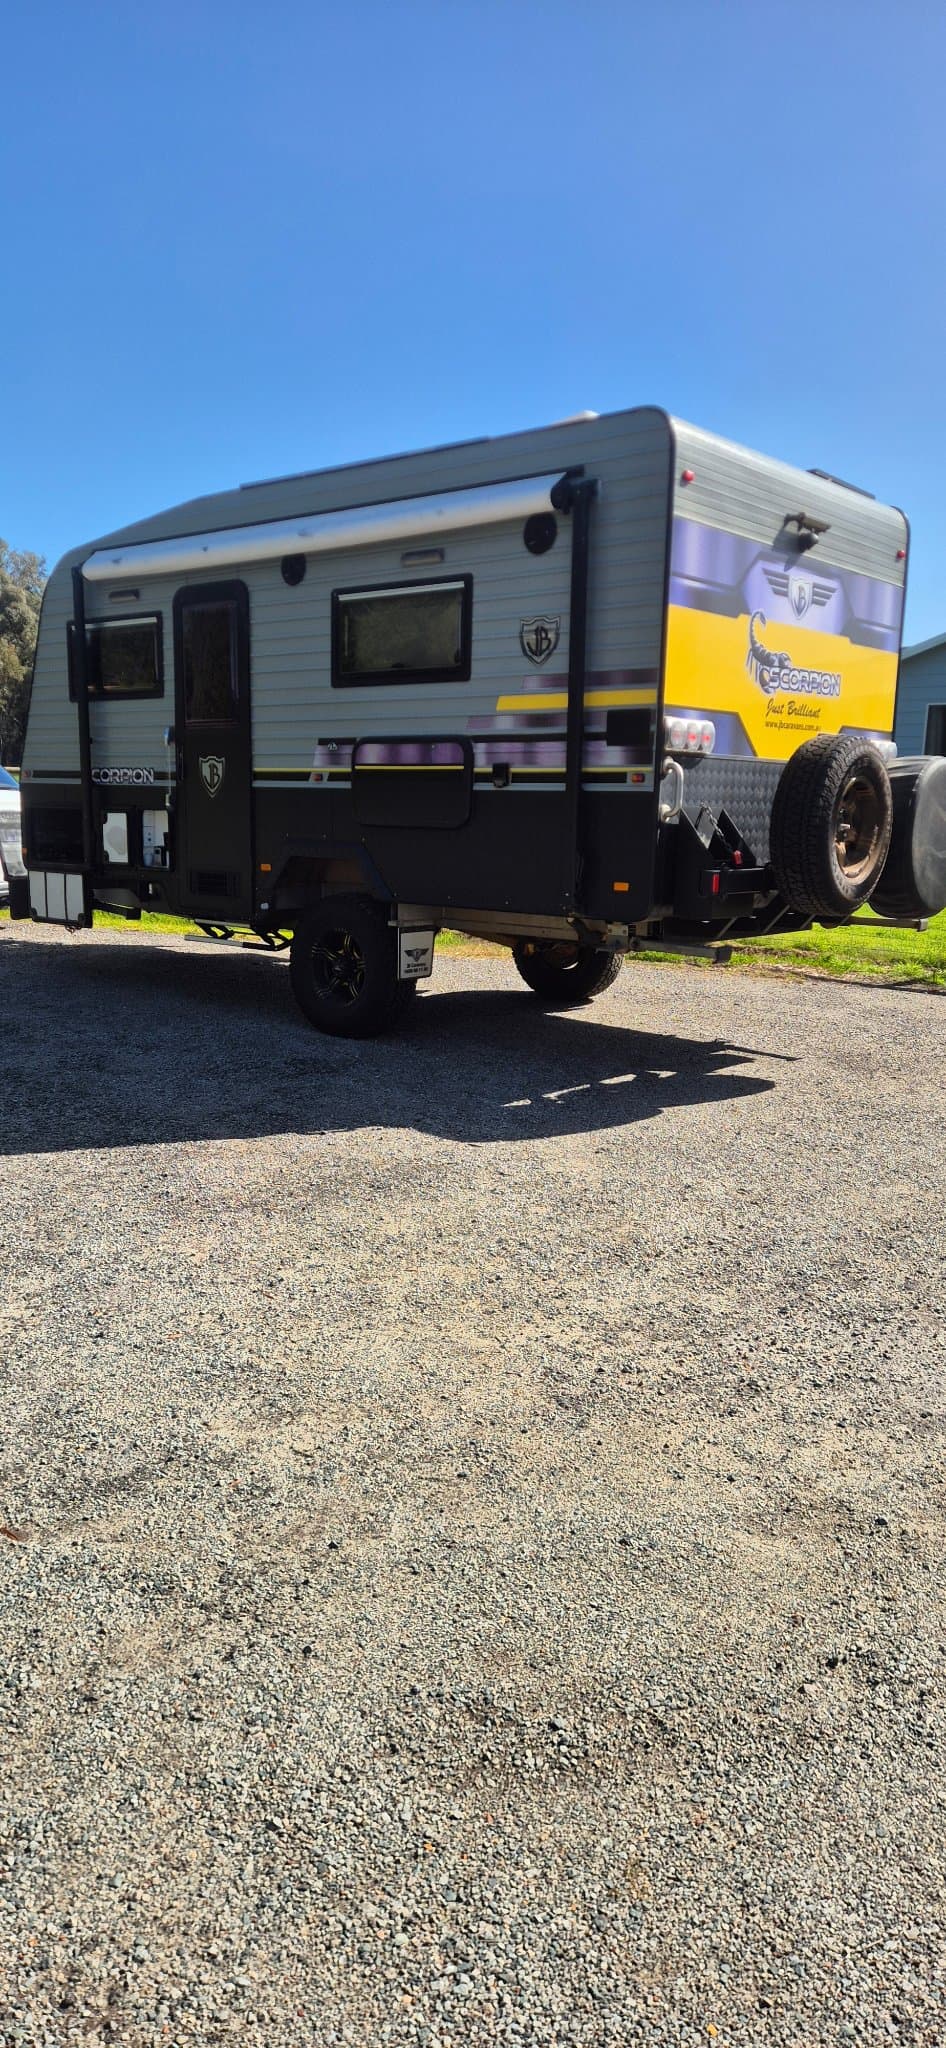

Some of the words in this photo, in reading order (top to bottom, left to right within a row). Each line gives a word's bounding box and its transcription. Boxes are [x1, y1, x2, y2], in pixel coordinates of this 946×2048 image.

[526, 625, 552, 656] JB
[769, 667, 841, 696] SCORPION
[765, 698, 785, 718] Just
[787, 700, 821, 718] Brilliant
[91, 767, 155, 784] CORPION
